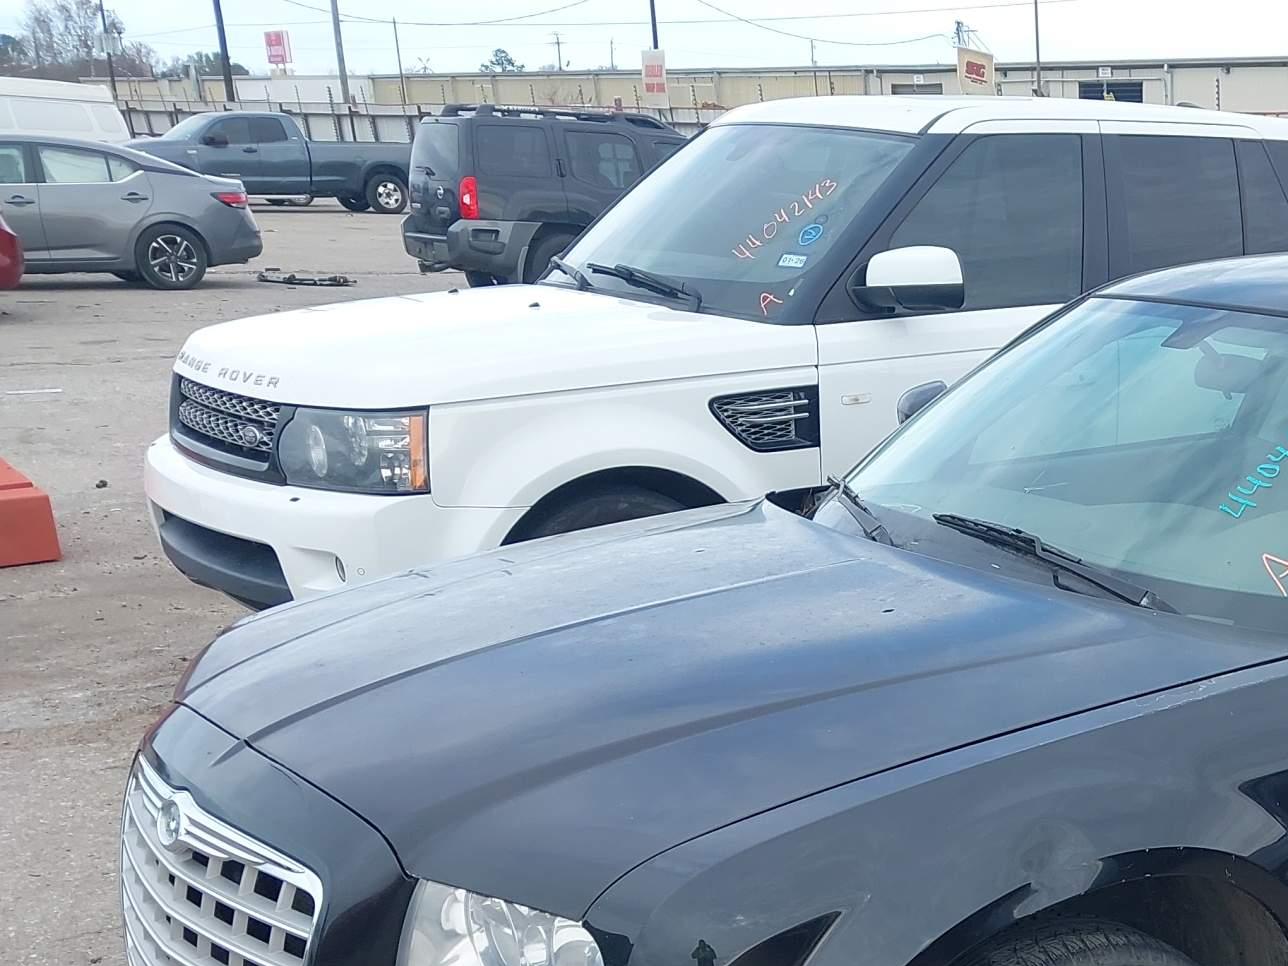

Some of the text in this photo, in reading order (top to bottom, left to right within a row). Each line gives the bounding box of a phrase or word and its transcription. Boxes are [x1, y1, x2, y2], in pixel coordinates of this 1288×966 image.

[731, 179, 838, 260] 44042143
[178, 351, 280, 388] RANGE ROVER
